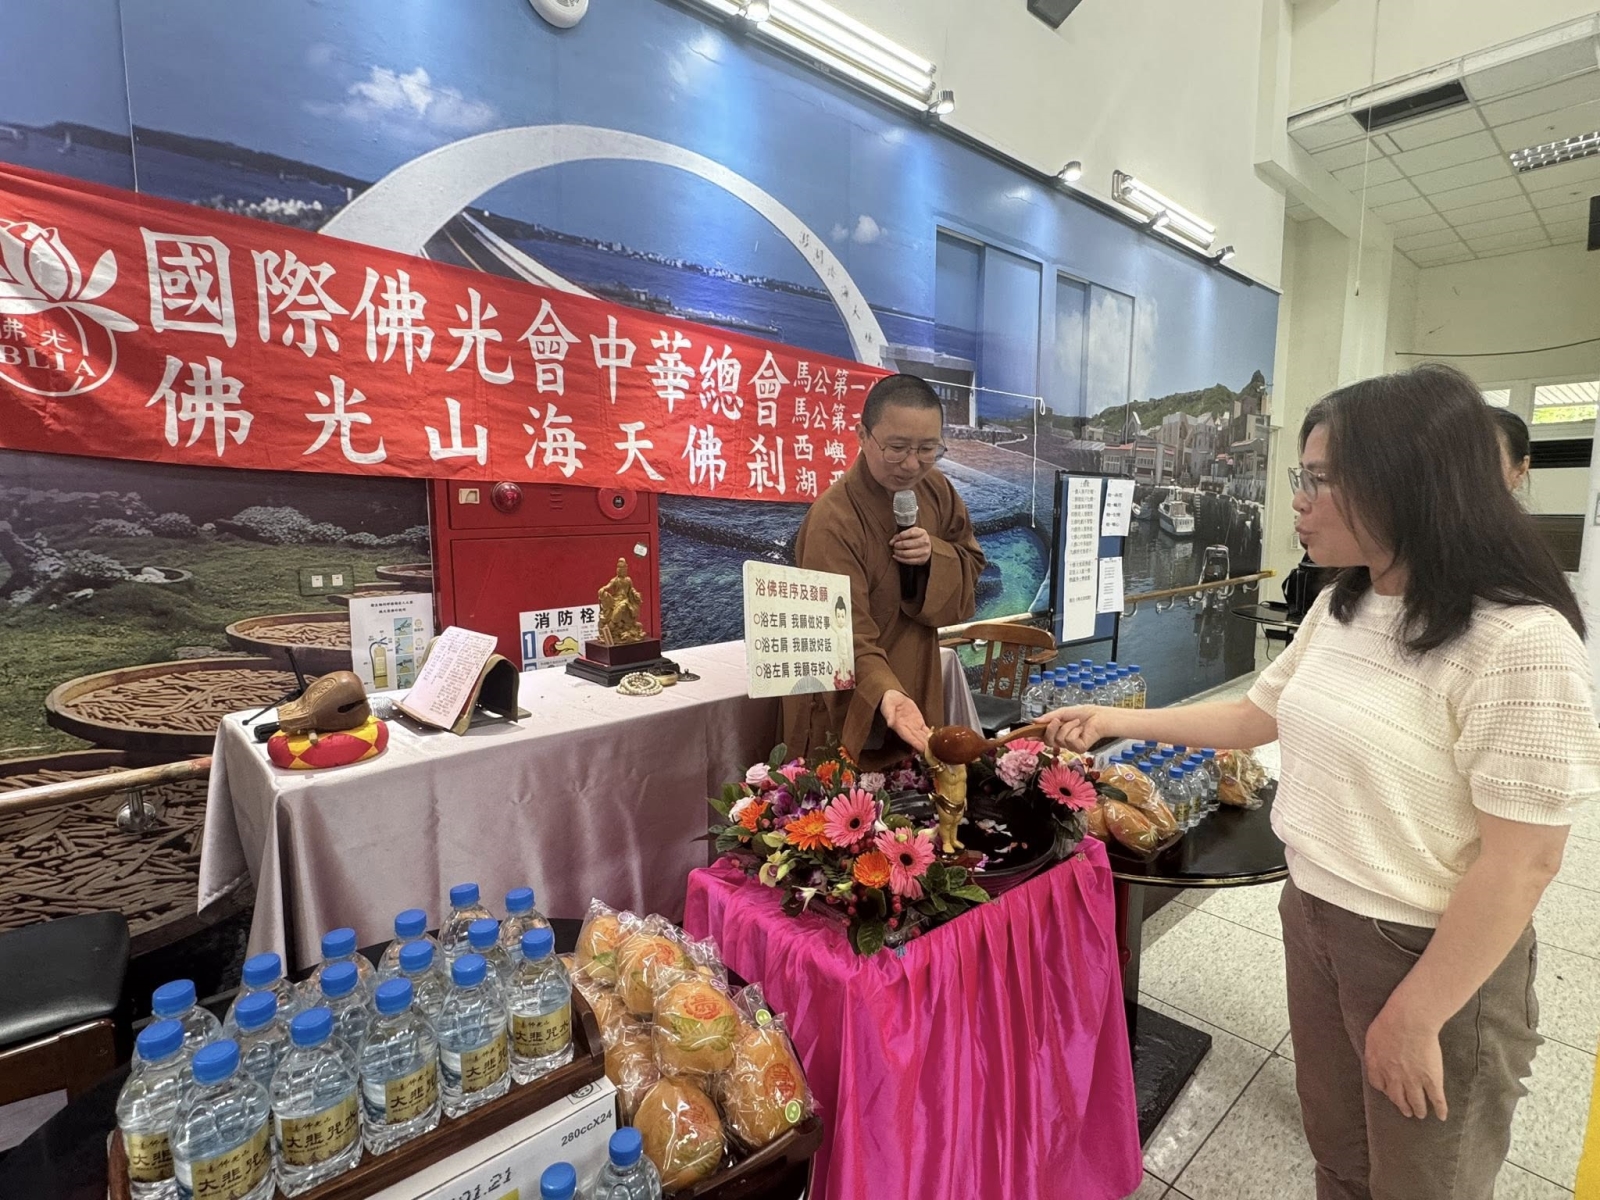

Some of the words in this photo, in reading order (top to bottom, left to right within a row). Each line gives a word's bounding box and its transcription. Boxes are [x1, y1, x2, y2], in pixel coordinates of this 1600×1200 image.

[140, 226, 789, 429] 國際佛光會中華總會
[0, 344, 97, 378] BLIA
[145, 354, 786, 495] 佛光山海天佛剎
[793, 435, 862, 466] 西嶼
[755, 578, 828, 602] 浴佛程序及發願
[535, 608, 595, 629] 消防栓
[560, 1109, 613, 1147] 280ccX24
